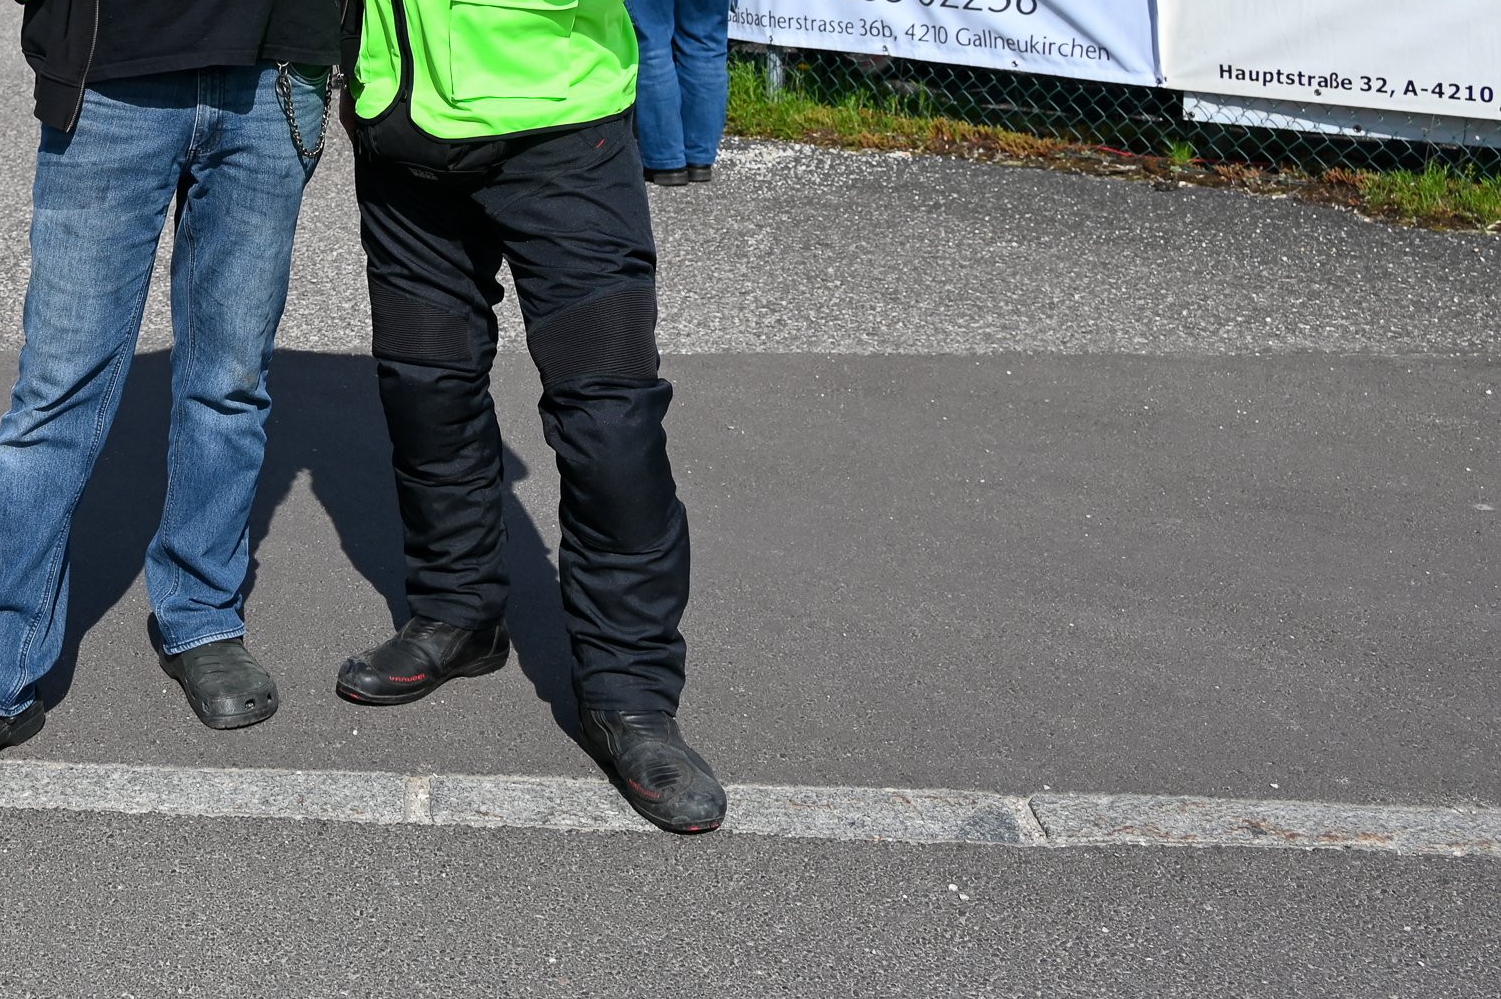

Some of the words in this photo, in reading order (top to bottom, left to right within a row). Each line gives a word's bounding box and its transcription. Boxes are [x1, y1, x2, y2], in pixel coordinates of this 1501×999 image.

[859, 18, 898, 43] 36b,
[904, 23, 949, 45] 4210
[955, 27, 1111, 62] Gallneukirchen
[1219, 64, 1353, 90] Hauptstraße
[1359, 75, 1396, 98] 32,
[1403, 80, 1494, 103] A-4210
